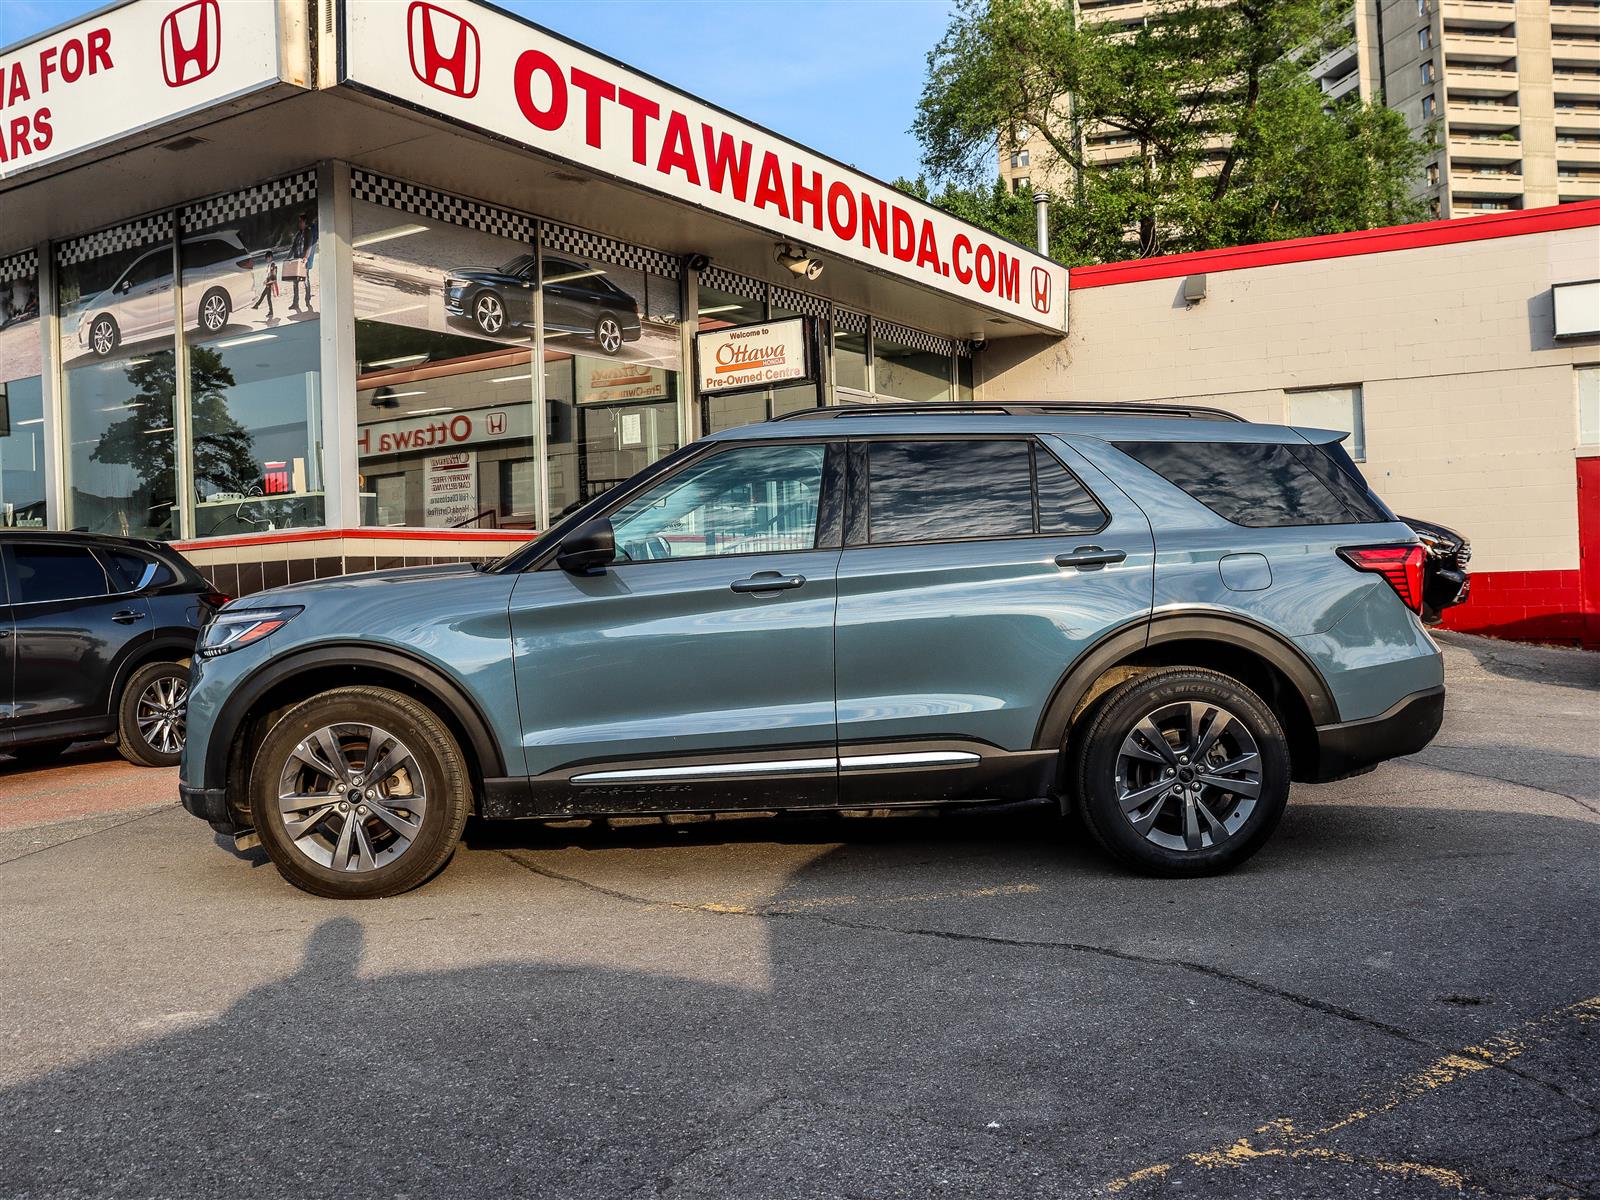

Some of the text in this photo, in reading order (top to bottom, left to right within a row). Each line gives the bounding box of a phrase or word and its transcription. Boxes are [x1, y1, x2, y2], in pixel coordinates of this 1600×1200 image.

[0, 27, 114, 111] A FOR
[514, 49, 1020, 304] OTTAWAHONDA.COM
[729, 328, 770, 340] Welcome to
[716, 342, 785, 365] Ottawa
[762, 357, 784, 366] HONDA
[706, 367, 801, 388] Pre-Owned Centre
[1175, 684, 1231, 700] MICHELIN
